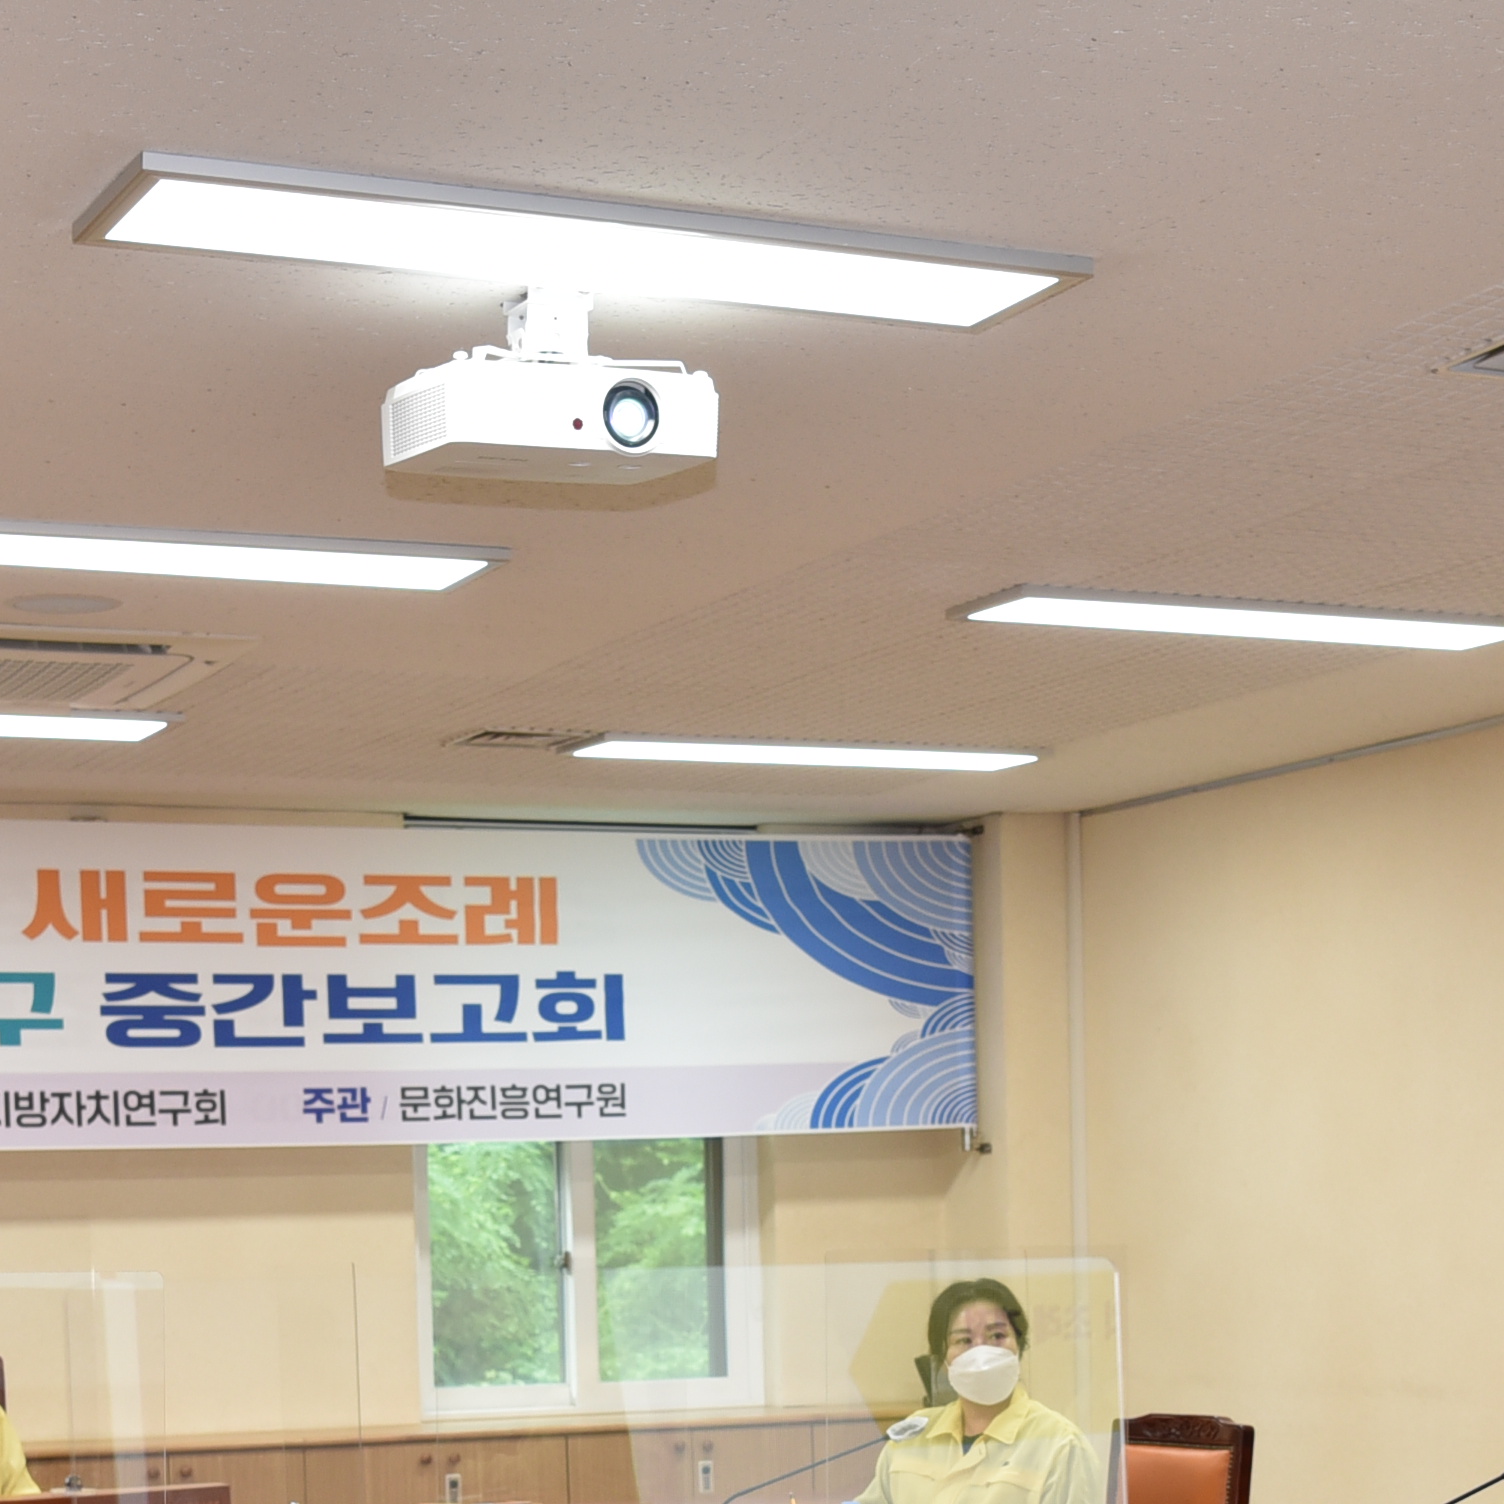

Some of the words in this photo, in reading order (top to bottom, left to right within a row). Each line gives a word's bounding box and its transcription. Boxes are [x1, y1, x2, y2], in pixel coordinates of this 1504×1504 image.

[22, 868, 558, 947] 새로운조례
[99, 970, 626, 1048] 중간보고회
[302, 1086, 372, 1124] 주관
[398, 1082, 627, 1123] 문화진흥연구원
